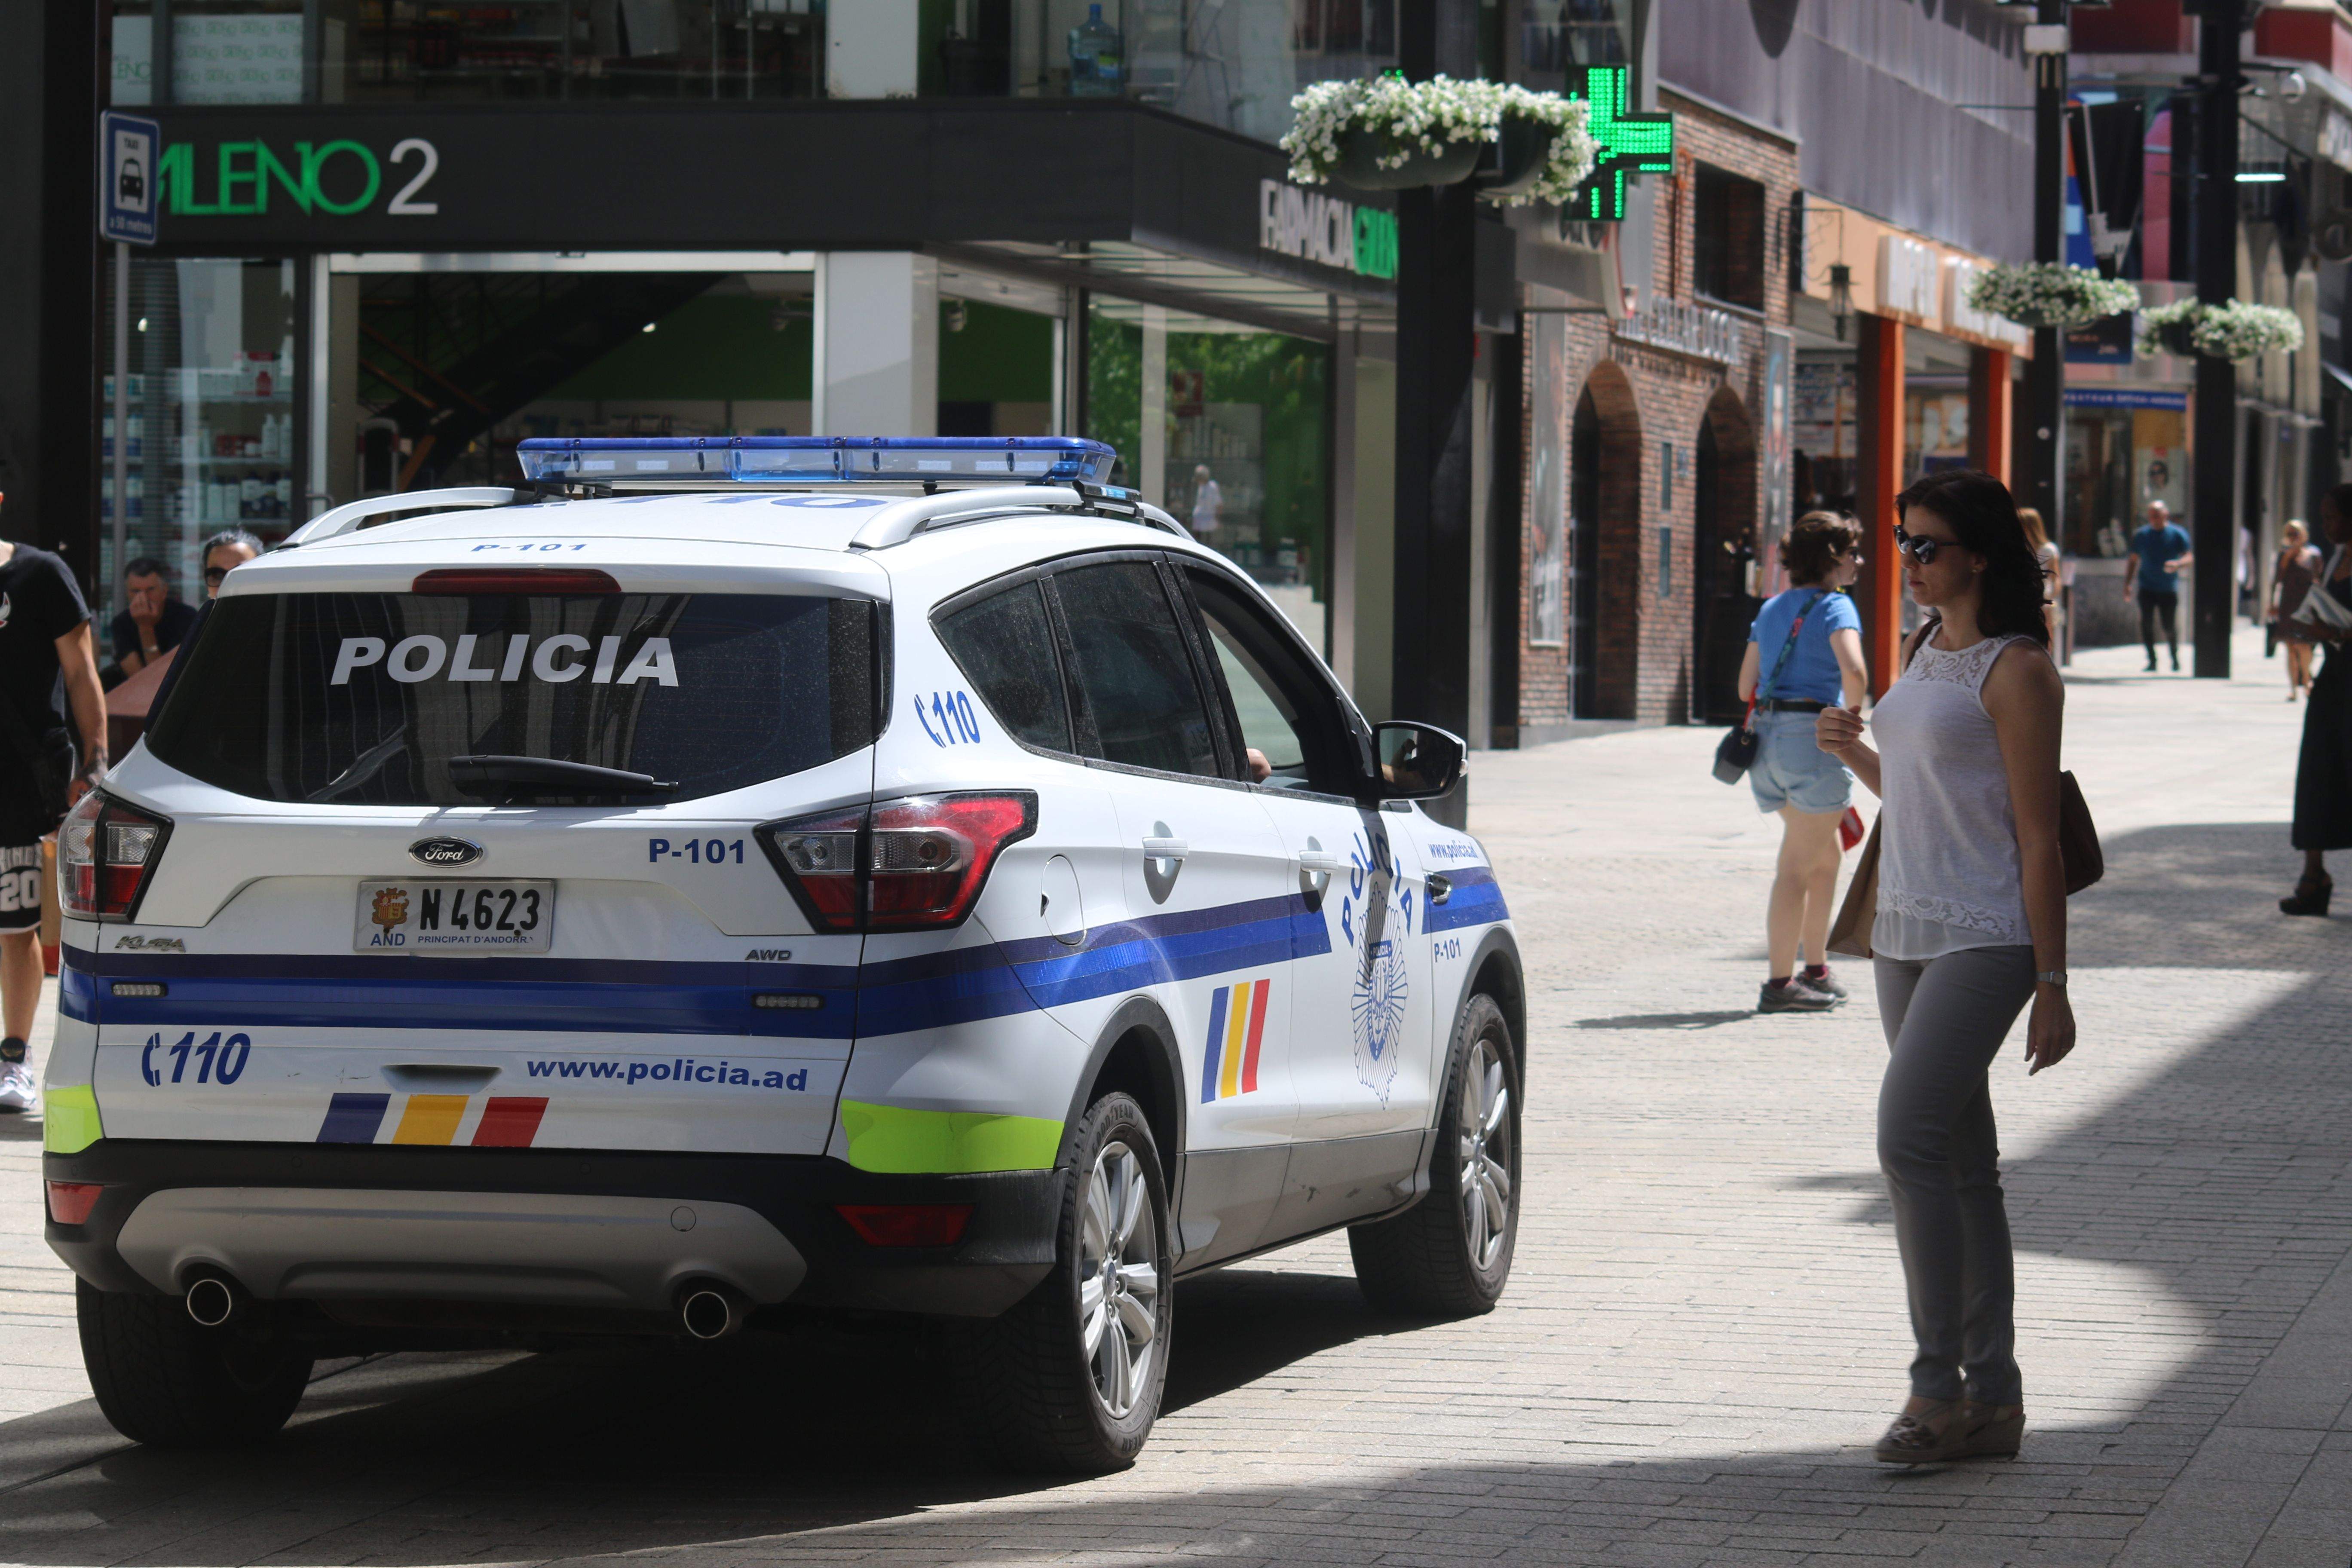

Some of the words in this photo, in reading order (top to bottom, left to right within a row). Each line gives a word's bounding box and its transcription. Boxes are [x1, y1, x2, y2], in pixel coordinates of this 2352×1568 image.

[387, 138, 439, 215] 2
[470, 544, 588, 552] P-101
[330, 634, 679, 687] POLICIA
[932, 690, 980, 744] 110
[425, 843, 464, 861] Ford
[649, 839, 744, 864] P-101
[0, 870, 41, 911] 20
[1341, 825, 1413, 949] POLICIA
[114, 935, 186, 953] KUGA
[371, 933, 405, 946] AND
[1434, 937, 1461, 963] P-101
[744, 949, 791, 961] AWD
[169, 1032, 251, 1085] 110
[527, 1059, 808, 1091] www.policia.ad
